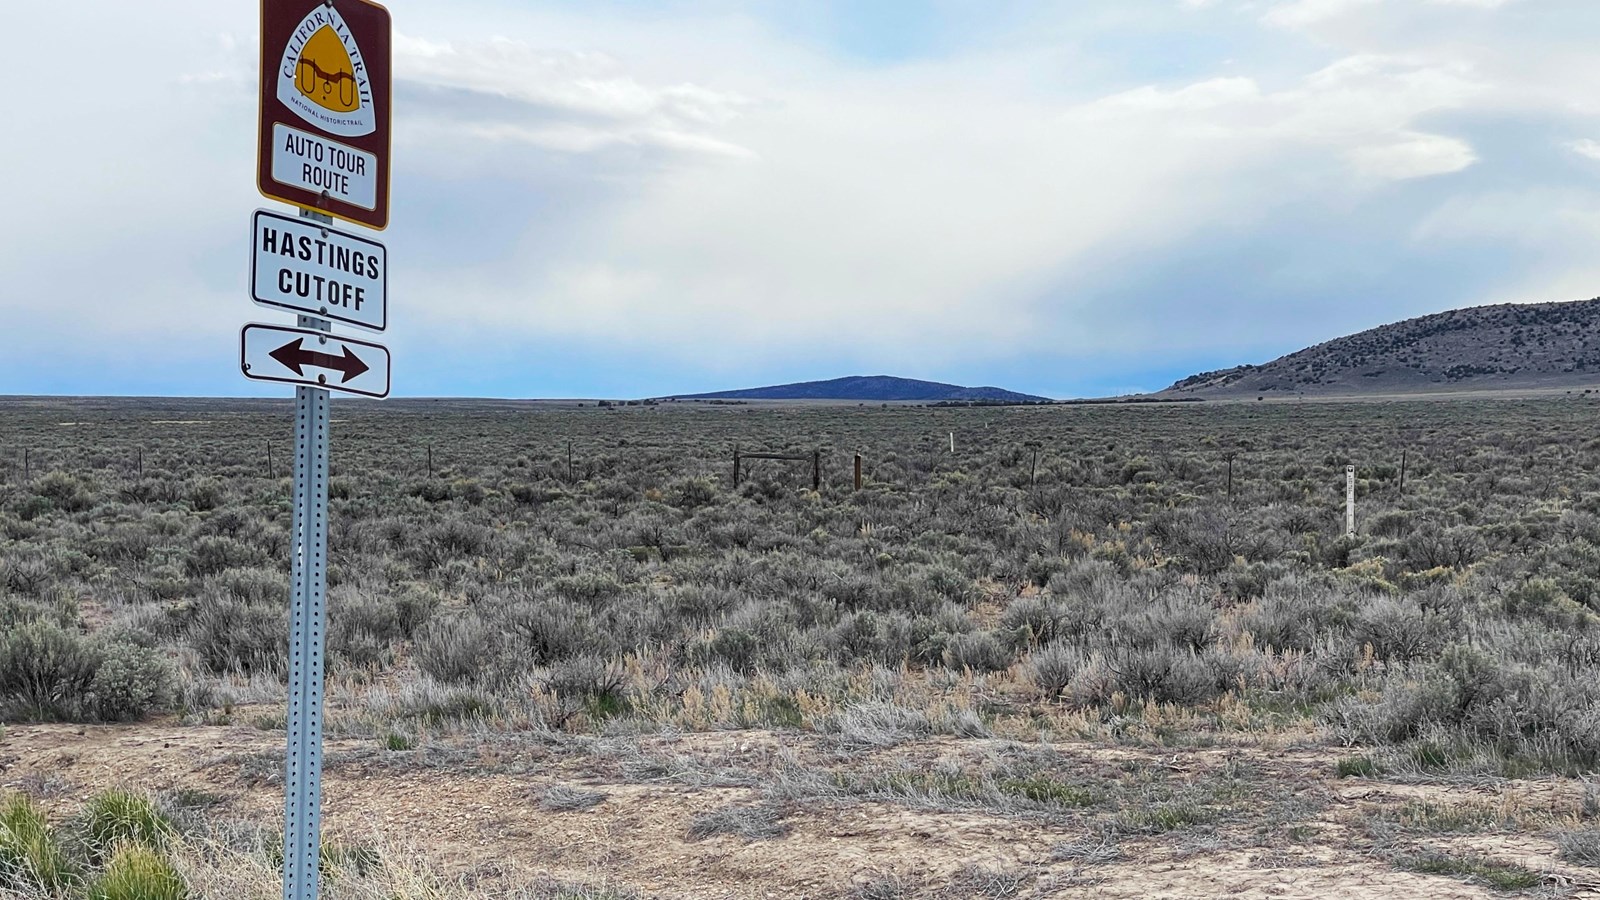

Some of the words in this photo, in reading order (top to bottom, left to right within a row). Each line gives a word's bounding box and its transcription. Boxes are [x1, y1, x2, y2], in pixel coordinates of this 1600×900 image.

[283, 11, 350, 79] CALIFORNIA
[349, 46, 370, 109] TRAIL
[290, 96, 319, 118] NATIONAL
[285, 133, 323, 162] AUTO
[328, 146, 365, 176] TOUR
[302, 163, 348, 195] ROUTE
[263, 227, 379, 280] HASTINGS
[278, 268, 365, 311] CUTOFF
